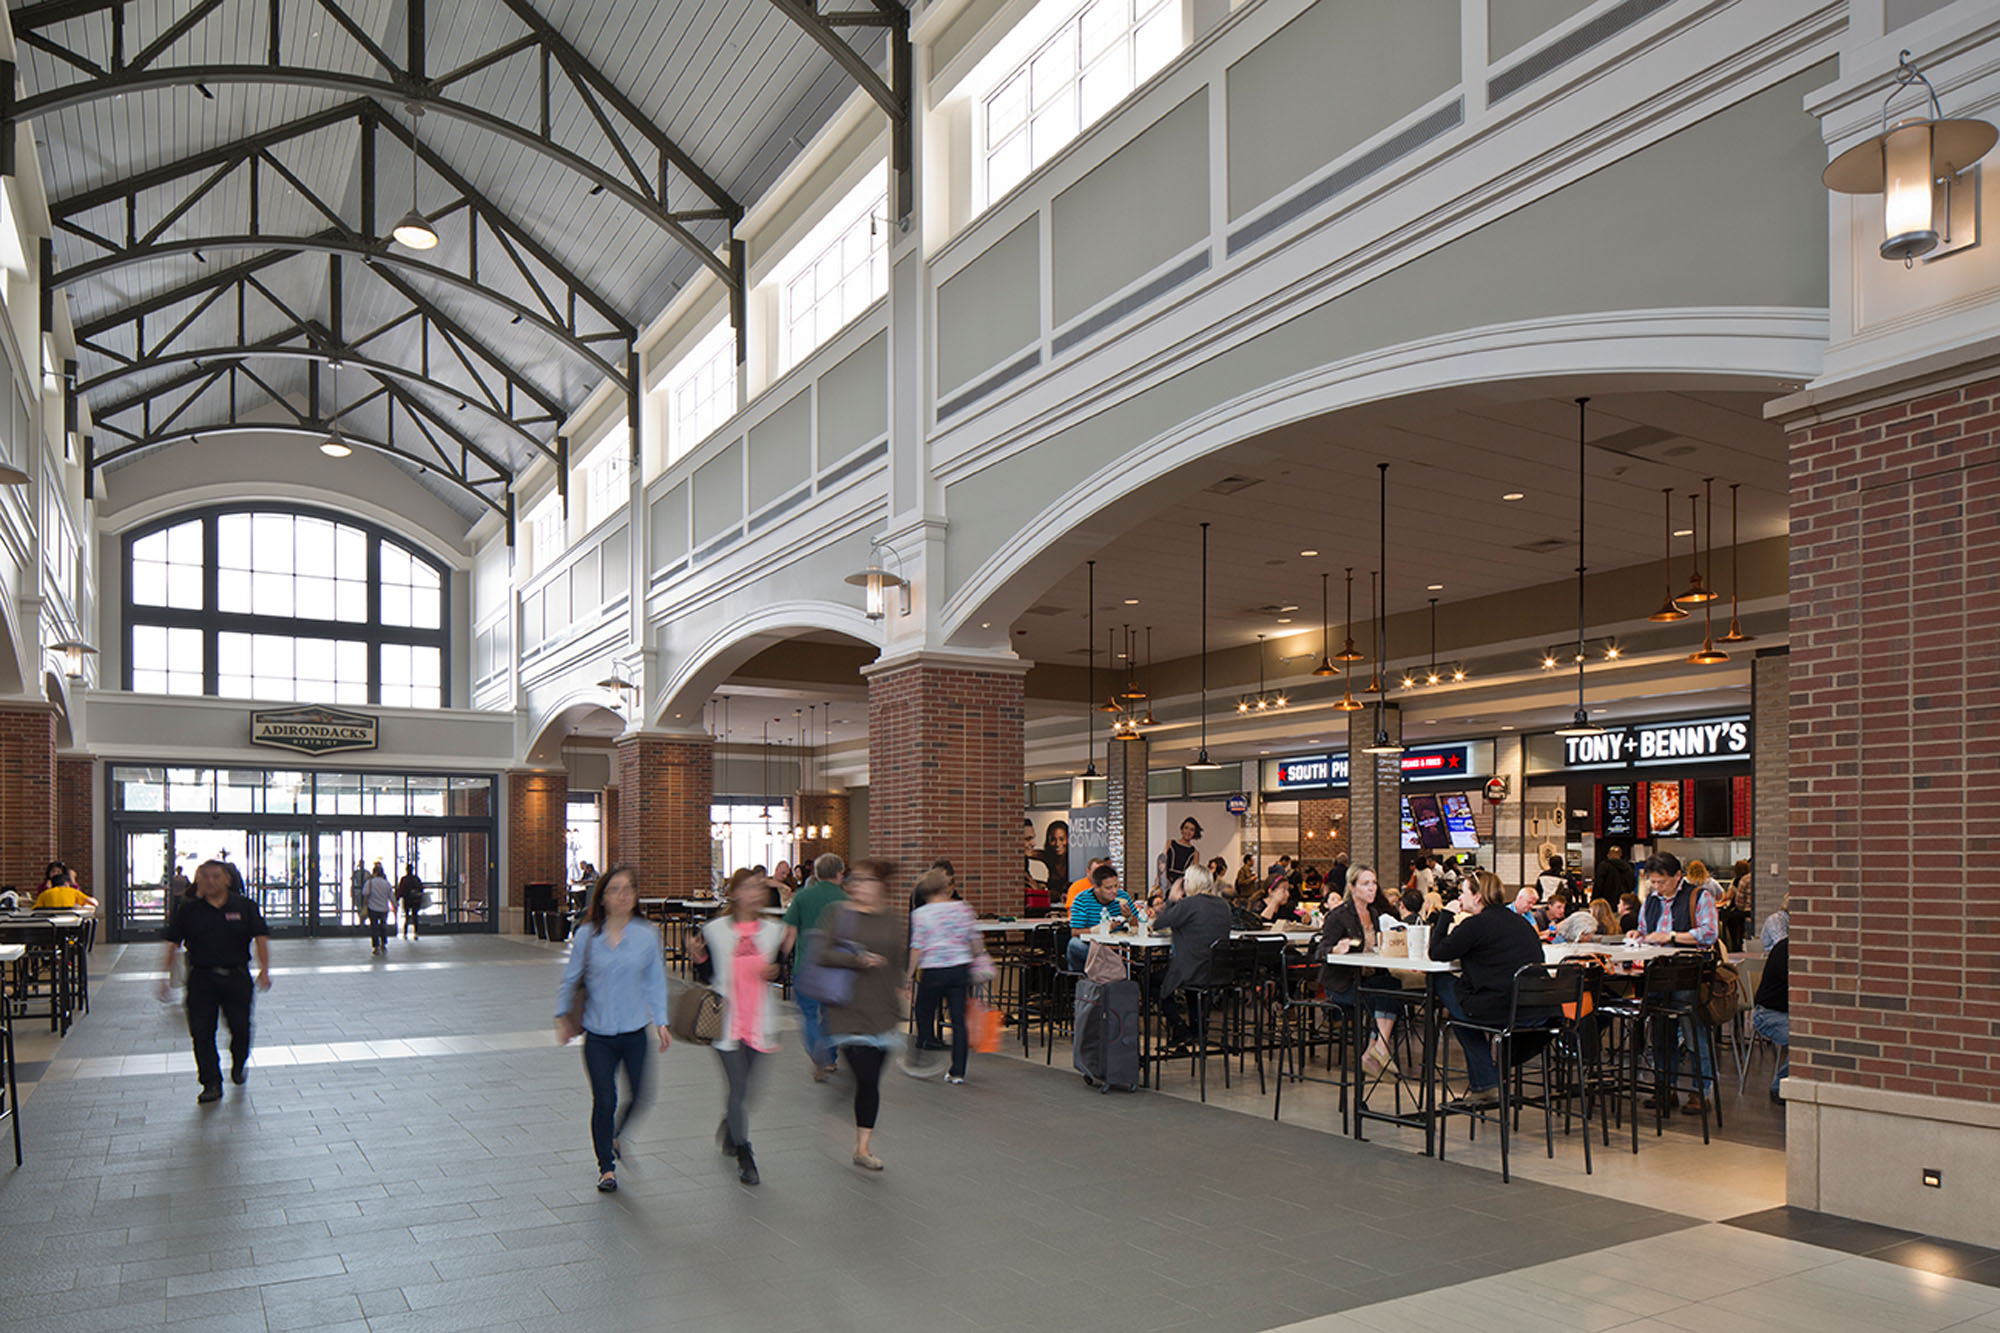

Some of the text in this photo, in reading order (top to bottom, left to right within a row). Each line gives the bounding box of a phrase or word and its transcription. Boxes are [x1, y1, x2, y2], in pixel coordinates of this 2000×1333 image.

[262, 725, 367, 739] ADIRONDACKS
[1566, 732, 1624, 764] TONY
[1640, 722, 1747, 758] BENNY'S
[1287, 761, 1348, 781] SOUTH PH
[1069, 817, 1096, 832] MELT
